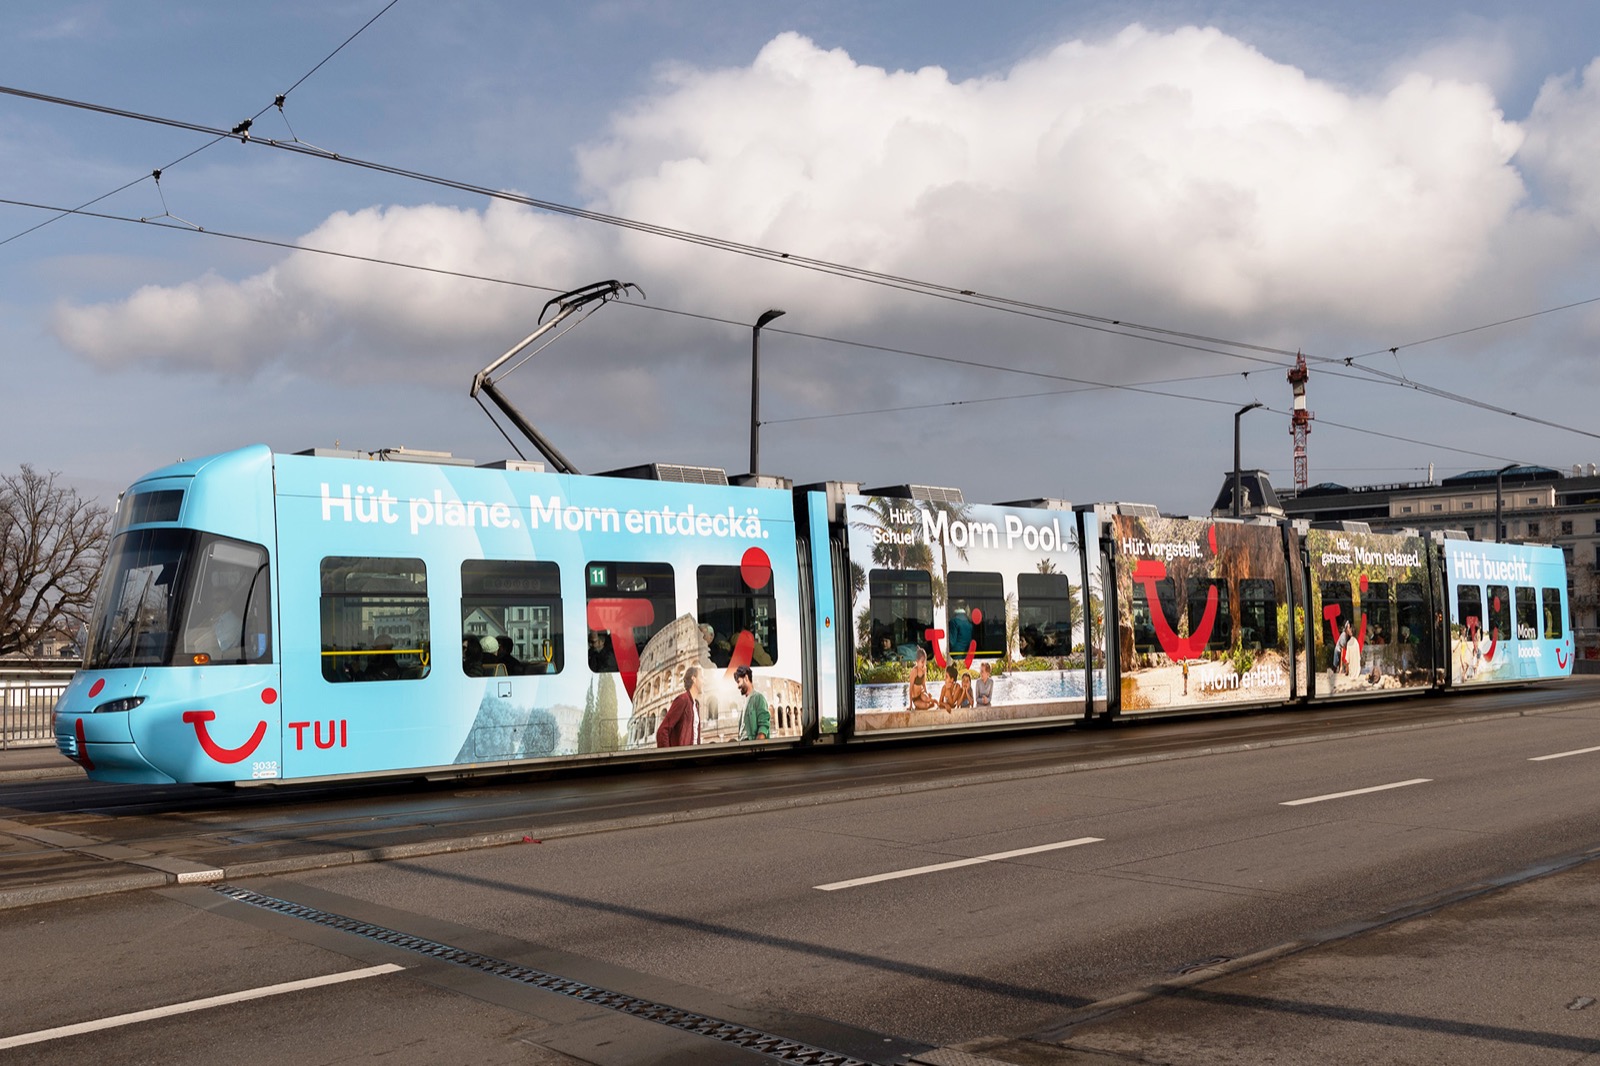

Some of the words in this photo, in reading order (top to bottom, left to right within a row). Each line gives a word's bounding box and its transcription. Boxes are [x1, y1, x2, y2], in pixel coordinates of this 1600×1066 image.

[320, 482, 399, 524] Hüt
[409, 488, 520, 535] plane.
[529, 494, 620, 532] Morn
[624, 503, 769, 539] entdeckä.
[889, 508, 914, 525] Hüt
[873, 527, 915, 545] Schuel
[921, 509, 999, 549] Morn
[1004, 514, 1068, 552] Pool.
[1122, 537, 1145, 556] Hüt
[1146, 540, 1203, 561] vorgstellt.
[1354, 546, 1382, 565] Morn
[1383, 548, 1421, 567] relaxed.
[592, 570, 604, 584] 11
[1453, 550, 1481, 580] Hüt
[1482, 553, 1531, 582] buecht.
[1200, 667, 1239, 691] Morn
[1241, 664, 1286, 688] erläbt.
[288, 719, 347, 751] TUI
[252, 760, 278, 771] 3032
